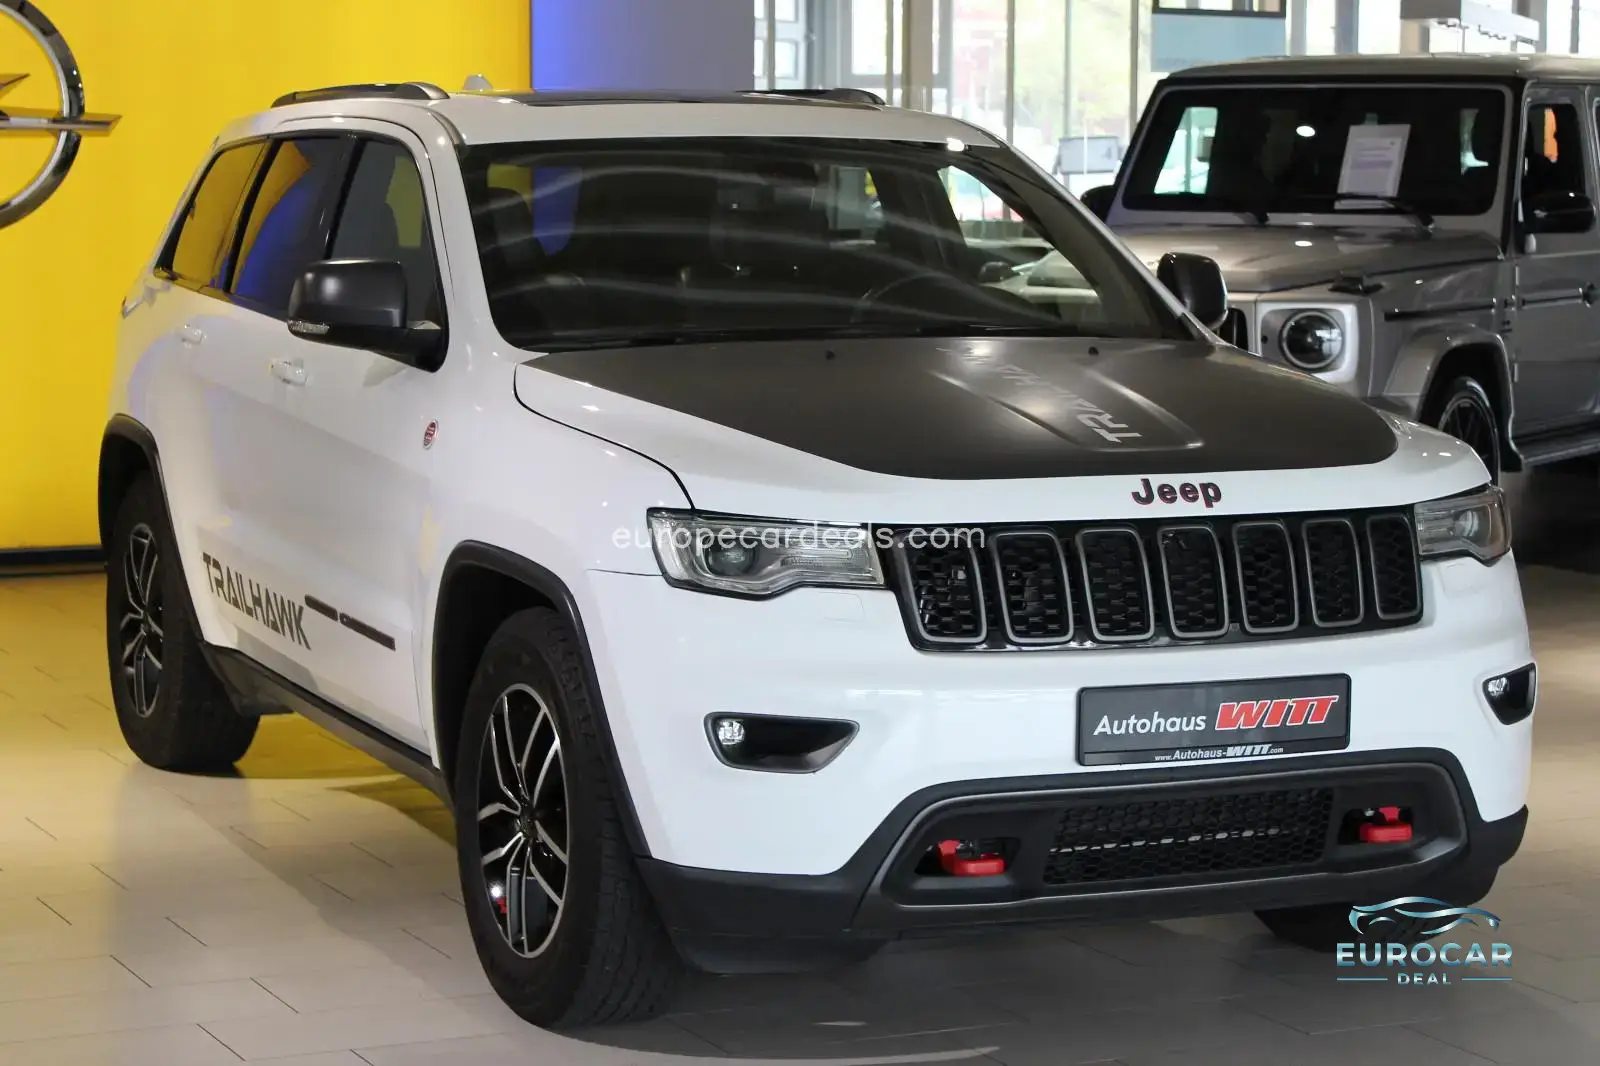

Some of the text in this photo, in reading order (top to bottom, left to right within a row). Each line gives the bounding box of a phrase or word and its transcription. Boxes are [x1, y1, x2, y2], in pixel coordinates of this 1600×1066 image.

[1131, 478, 1222, 508] Jeep
[203, 552, 312, 650] TRAILHAWK
[1093, 695, 1339, 736] Autohaus WITT
[1155, 744, 1283, 761] www.Autohaus-WITT.com
